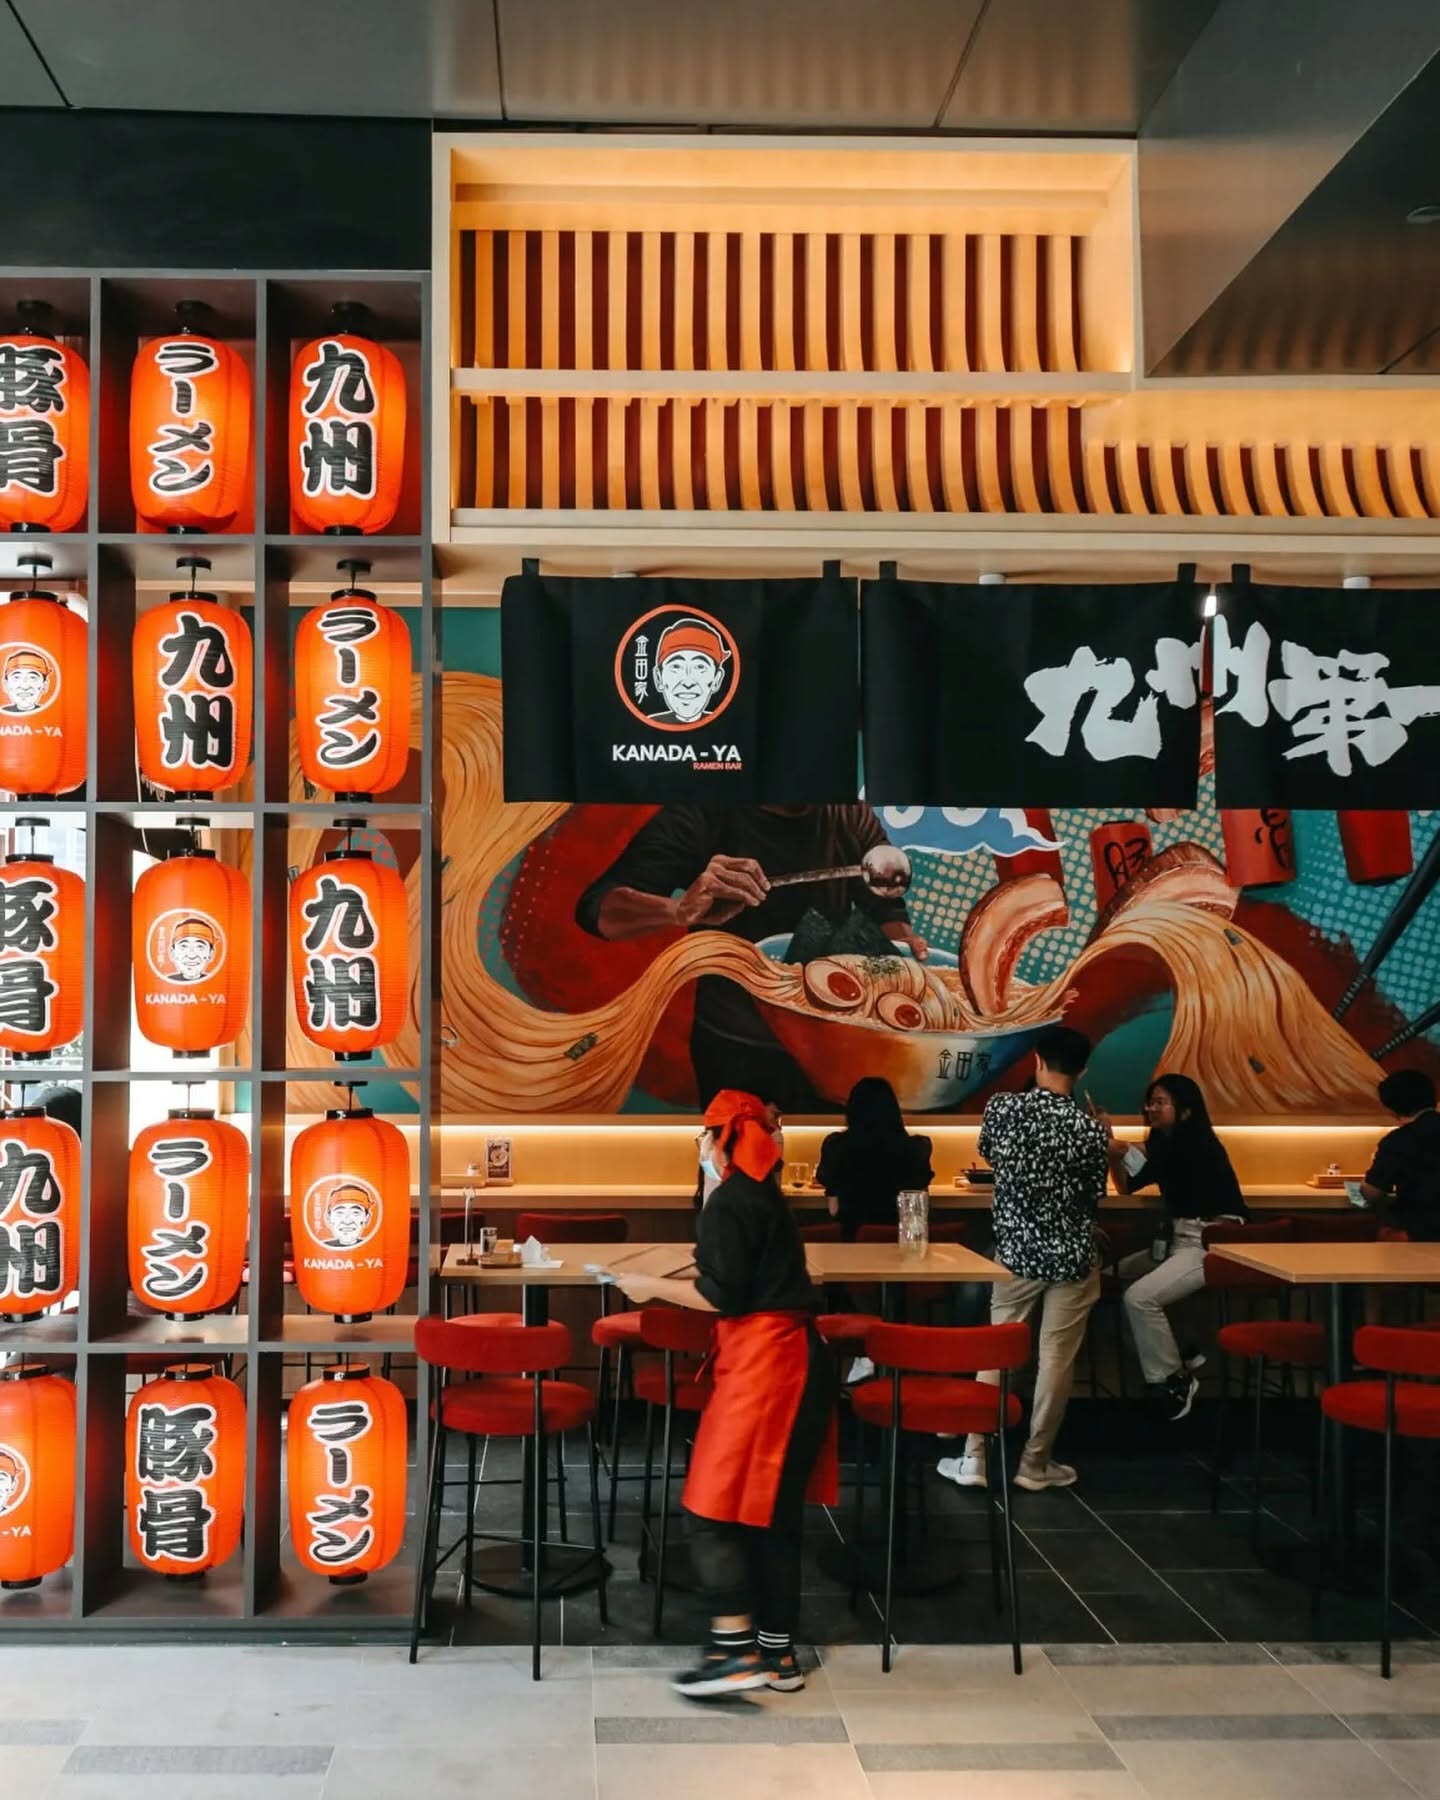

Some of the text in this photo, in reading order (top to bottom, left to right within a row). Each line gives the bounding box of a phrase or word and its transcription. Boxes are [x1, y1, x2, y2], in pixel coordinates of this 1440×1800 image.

[149, 342, 217, 495] ラーメン
[302, 342, 376, 499] 九州
[159, 612, 233, 771] 九州
[316, 607, 381, 769] ラーメン
[693, 762, 742, 770] RAMEN BAR
[303, 873, 379, 1031] 九州
[141, 1138, 212, 1300] ラーメン
[136, 1403, 217, 1561] 豚骨
[306, 1400, 374, 1565] ラーメン
